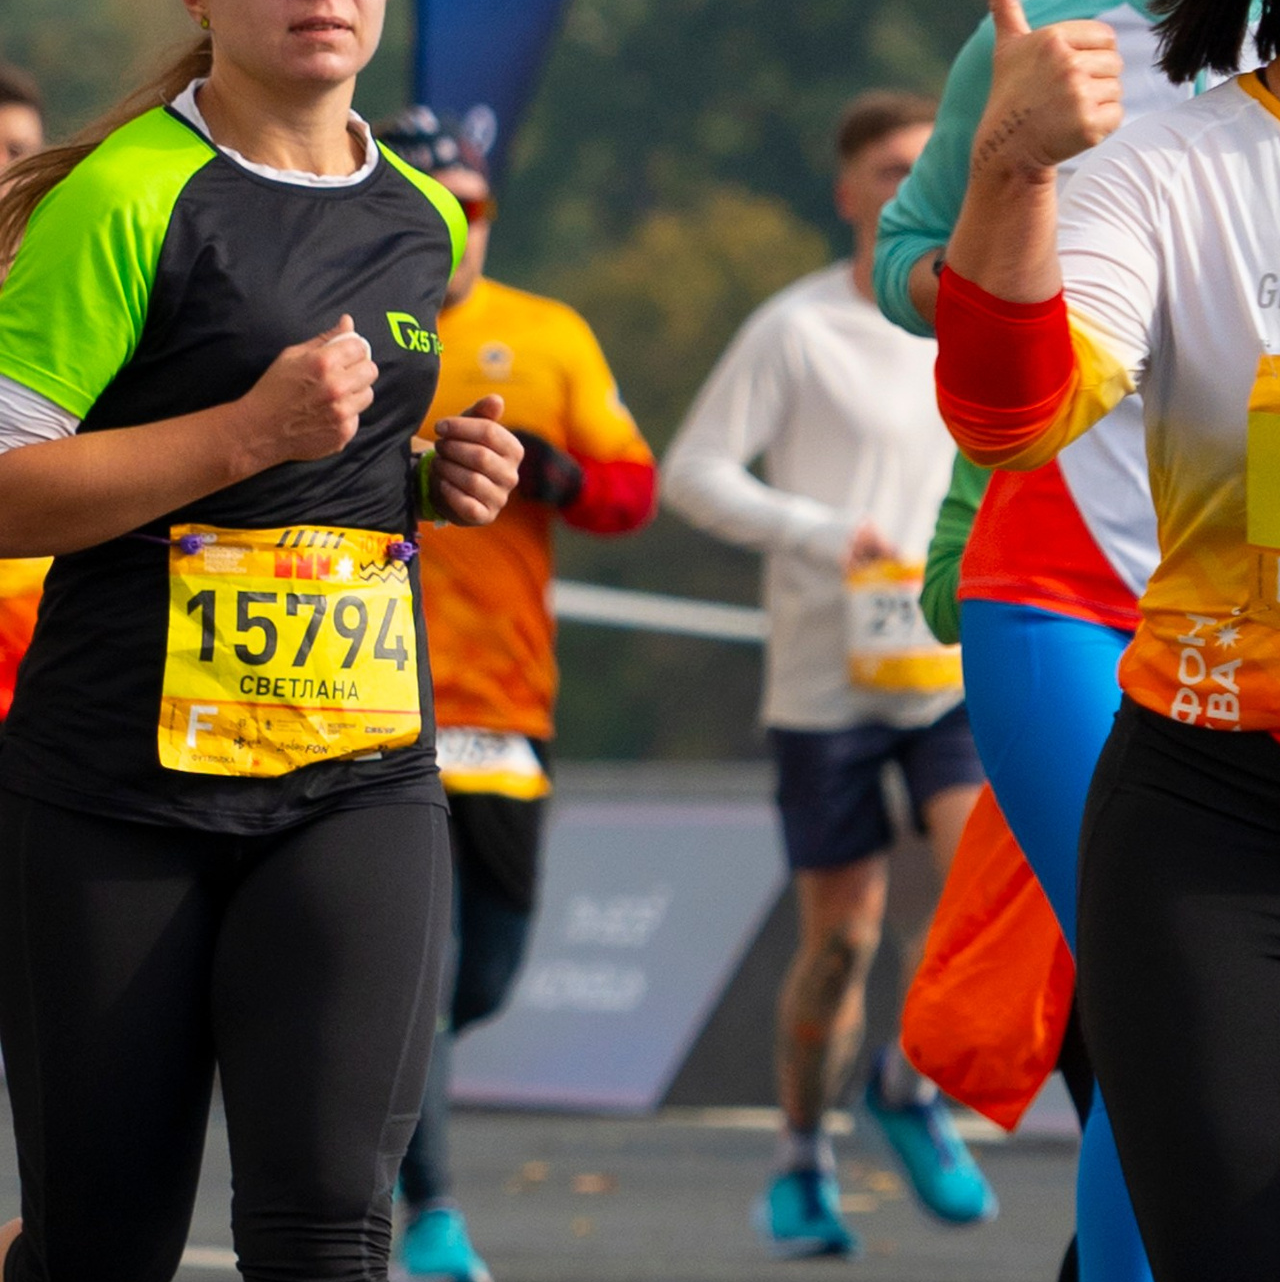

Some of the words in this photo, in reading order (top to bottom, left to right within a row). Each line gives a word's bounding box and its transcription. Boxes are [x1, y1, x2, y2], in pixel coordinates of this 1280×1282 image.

[406, 328, 431, 354] X5
[186, 589, 409, 673] 15794
[239, 674, 360, 701] СВЕТЛАНА
[1205, 658, 1243, 732] ВА
[185, 704, 219, 748] F
